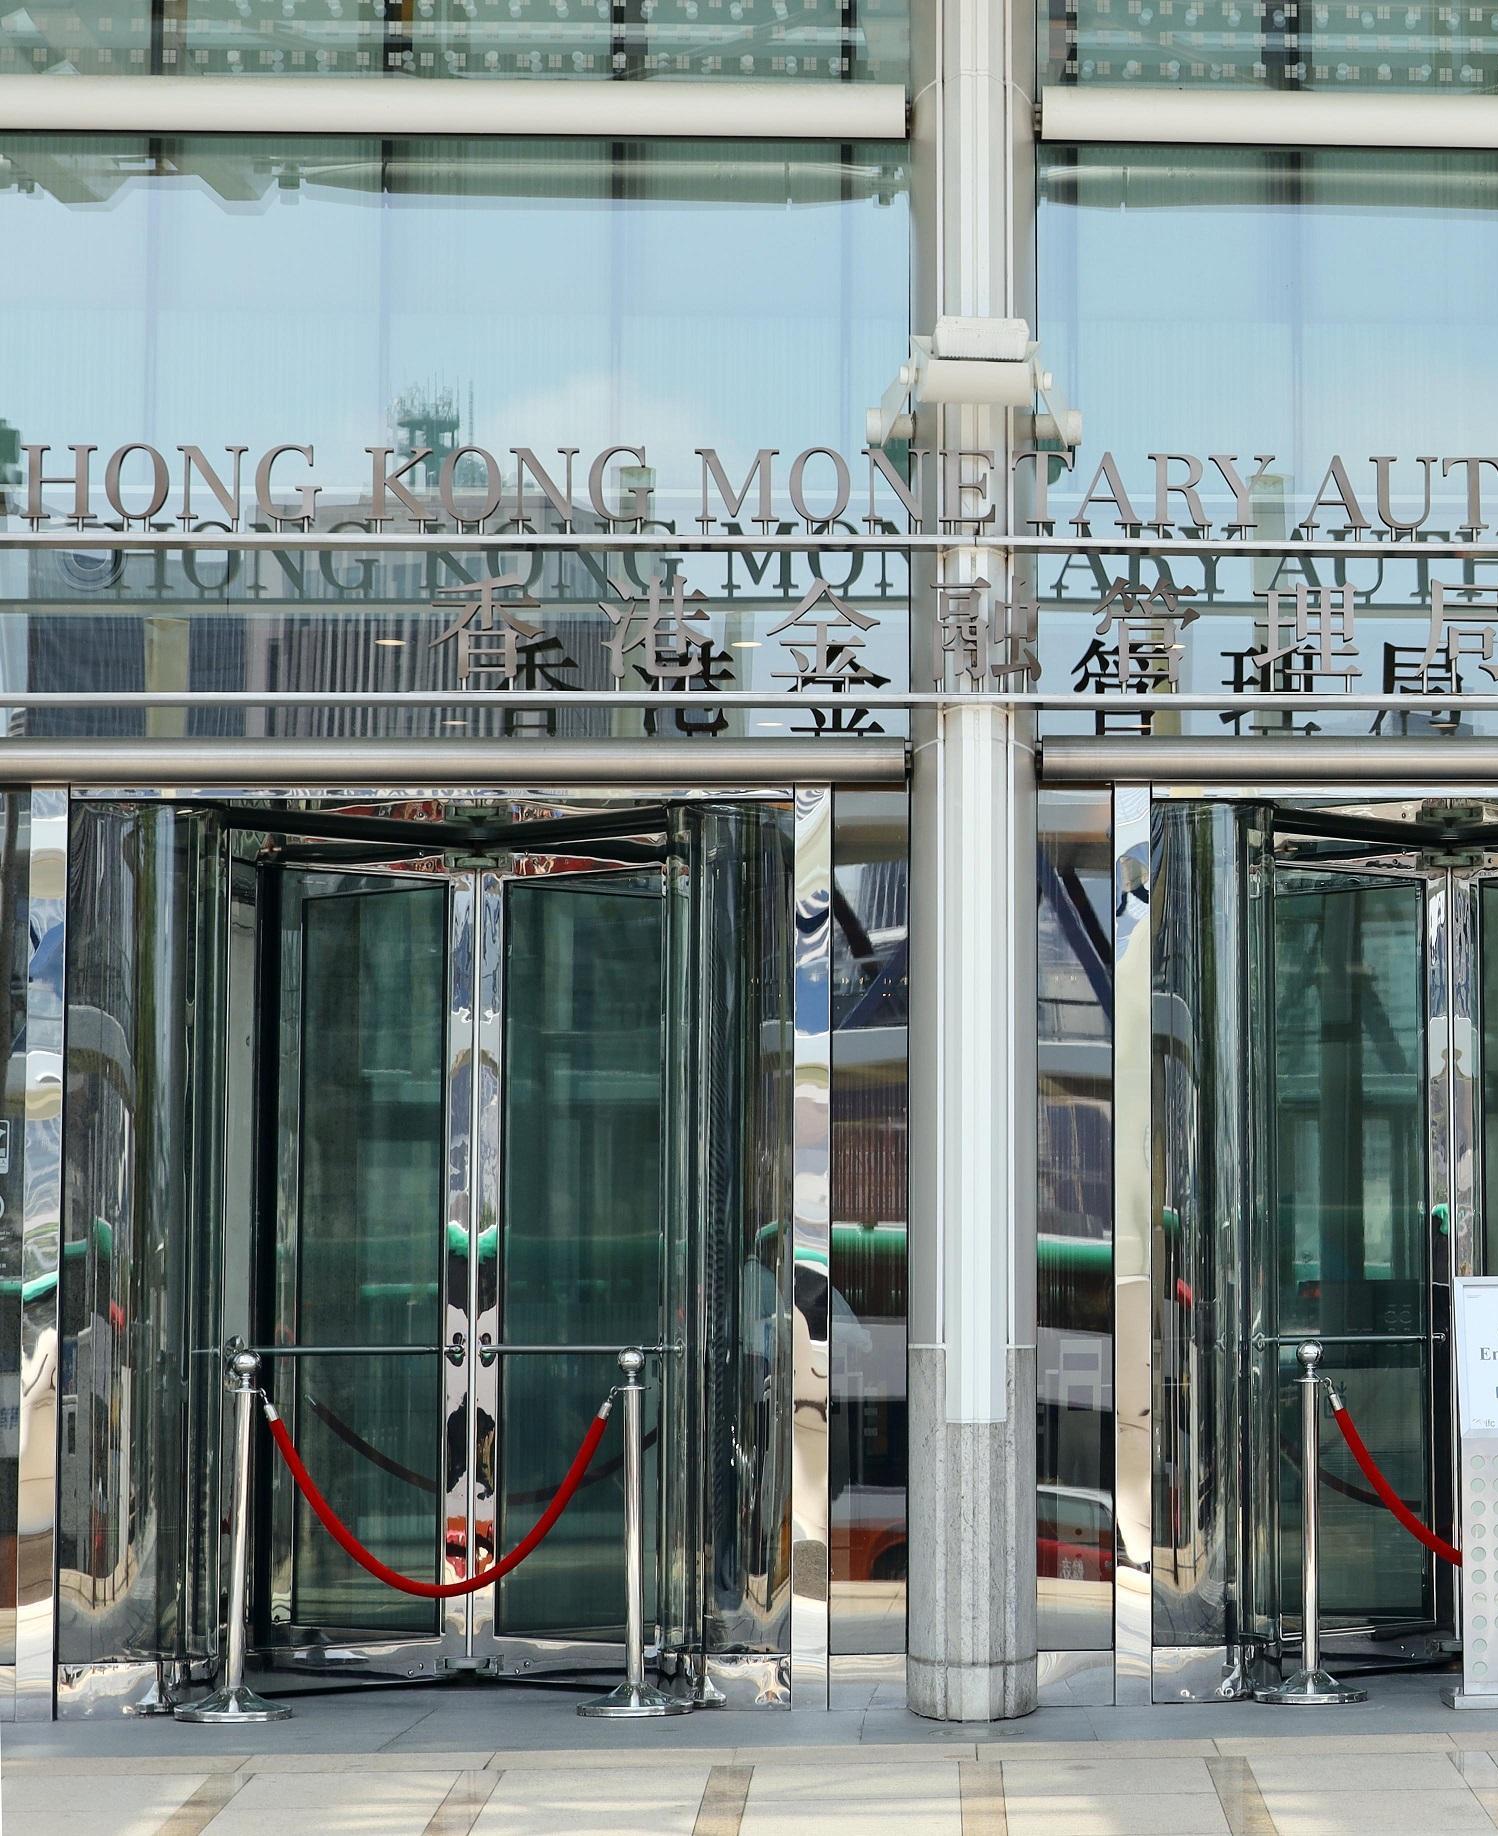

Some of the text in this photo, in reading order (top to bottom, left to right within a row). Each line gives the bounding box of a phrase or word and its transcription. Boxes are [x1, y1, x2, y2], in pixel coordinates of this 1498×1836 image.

[20, 442, 322, 522] HONG
[364, 445, 654, 523] KONG
[695, 446, 1274, 528] MONETARY
